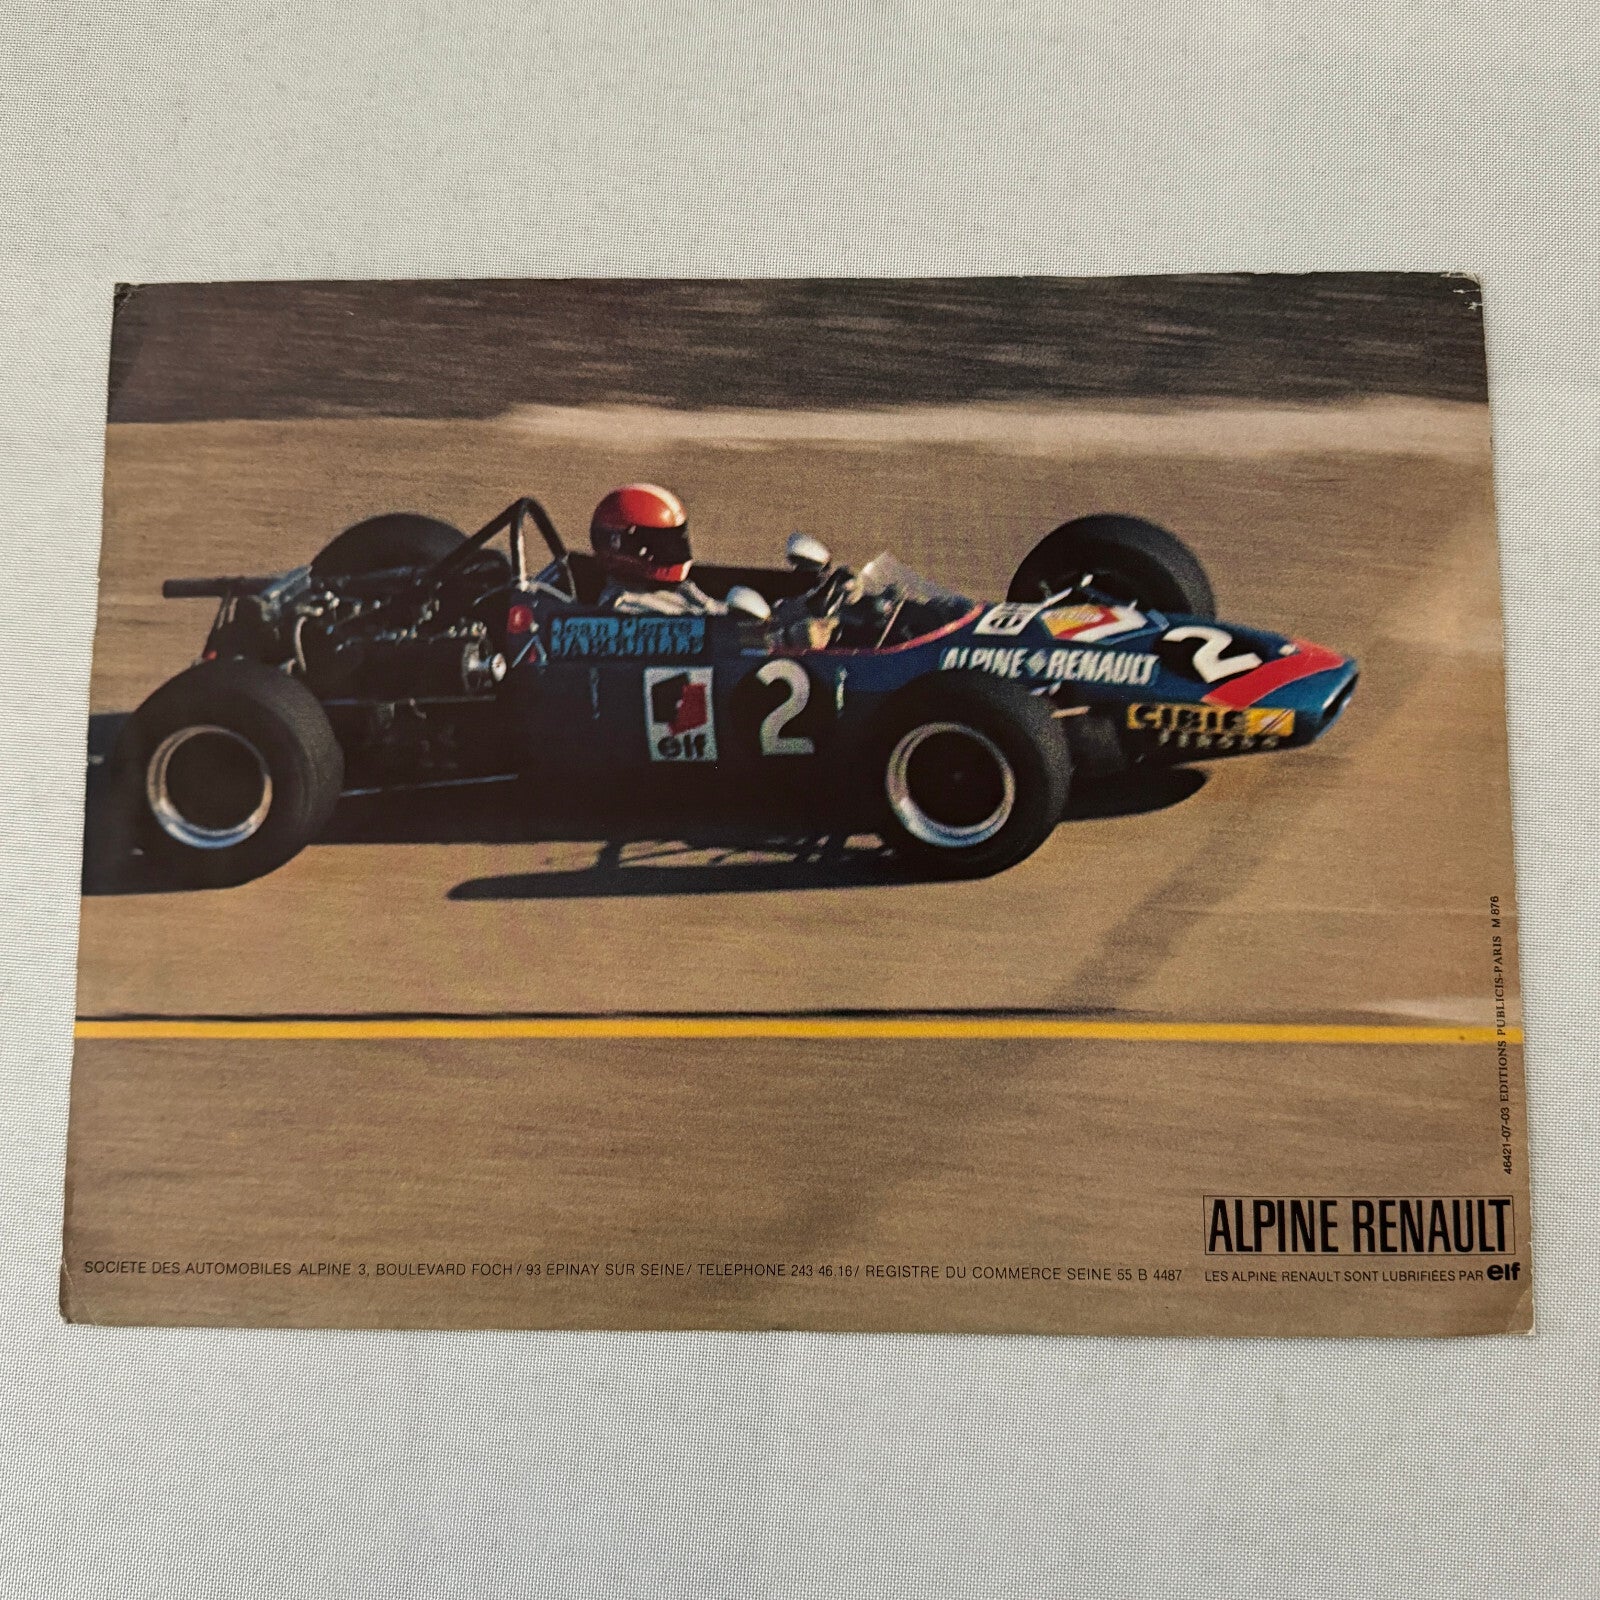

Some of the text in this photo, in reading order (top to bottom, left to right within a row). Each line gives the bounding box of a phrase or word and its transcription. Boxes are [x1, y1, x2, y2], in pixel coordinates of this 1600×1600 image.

[943, 648, 1160, 686] ALPINE RENAULT
[1162, 625, 1264, 684] 2
[756, 657, 815, 756] 2
[656, 733, 707, 760] elf
[1490, 896, 1513, 1175] 46421-07-03 EDITIONS PUBLICIS-PARIS M 876
[1208, 1199, 1510, 1253] ALPINE RENAULT
[83, 1260, 147, 1274] SOCIETE
[151, 1261, 181, 1275] DES
[185, 1262, 292, 1276] AUTOMOBILES
[298, 1263, 351, 1276] ALPINE
[357, 1263, 371, 1278] 3,
[376, 1263, 466, 1277] BOULEVARD
[472, 1264, 513, 1277] FOCH
[526, 1264, 542, 1277] 93
[546, 1263, 600, 1276] EPINAY
[605, 1263, 635, 1276] SUR
[699, 1264, 786, 1277] TELEPHONE
[791, 1265, 814, 1278] 243
[865, 1265, 940, 1279] REGISTRE
[946, 1266, 966, 1279] DU
[972, 1266, 1062, 1280] COMMERCE
[1067, 1267, 1112, 1281] SEINE
[1117, 1268, 1133, 1281] 55
[1138, 1268, 1148, 1281] B
[1153, 1268, 1182, 1282] 4487
[1205, 1271, 1229, 1283] LES
[1232, 1271, 1277, 1283] ALPINE
[1282, 1271, 1341, 1283] RENAULT
[1344, 1271, 1379, 1283] SONT
[1459, 1270, 1484, 1282] PAR
[1487, 1262, 1521, 1281] elf
